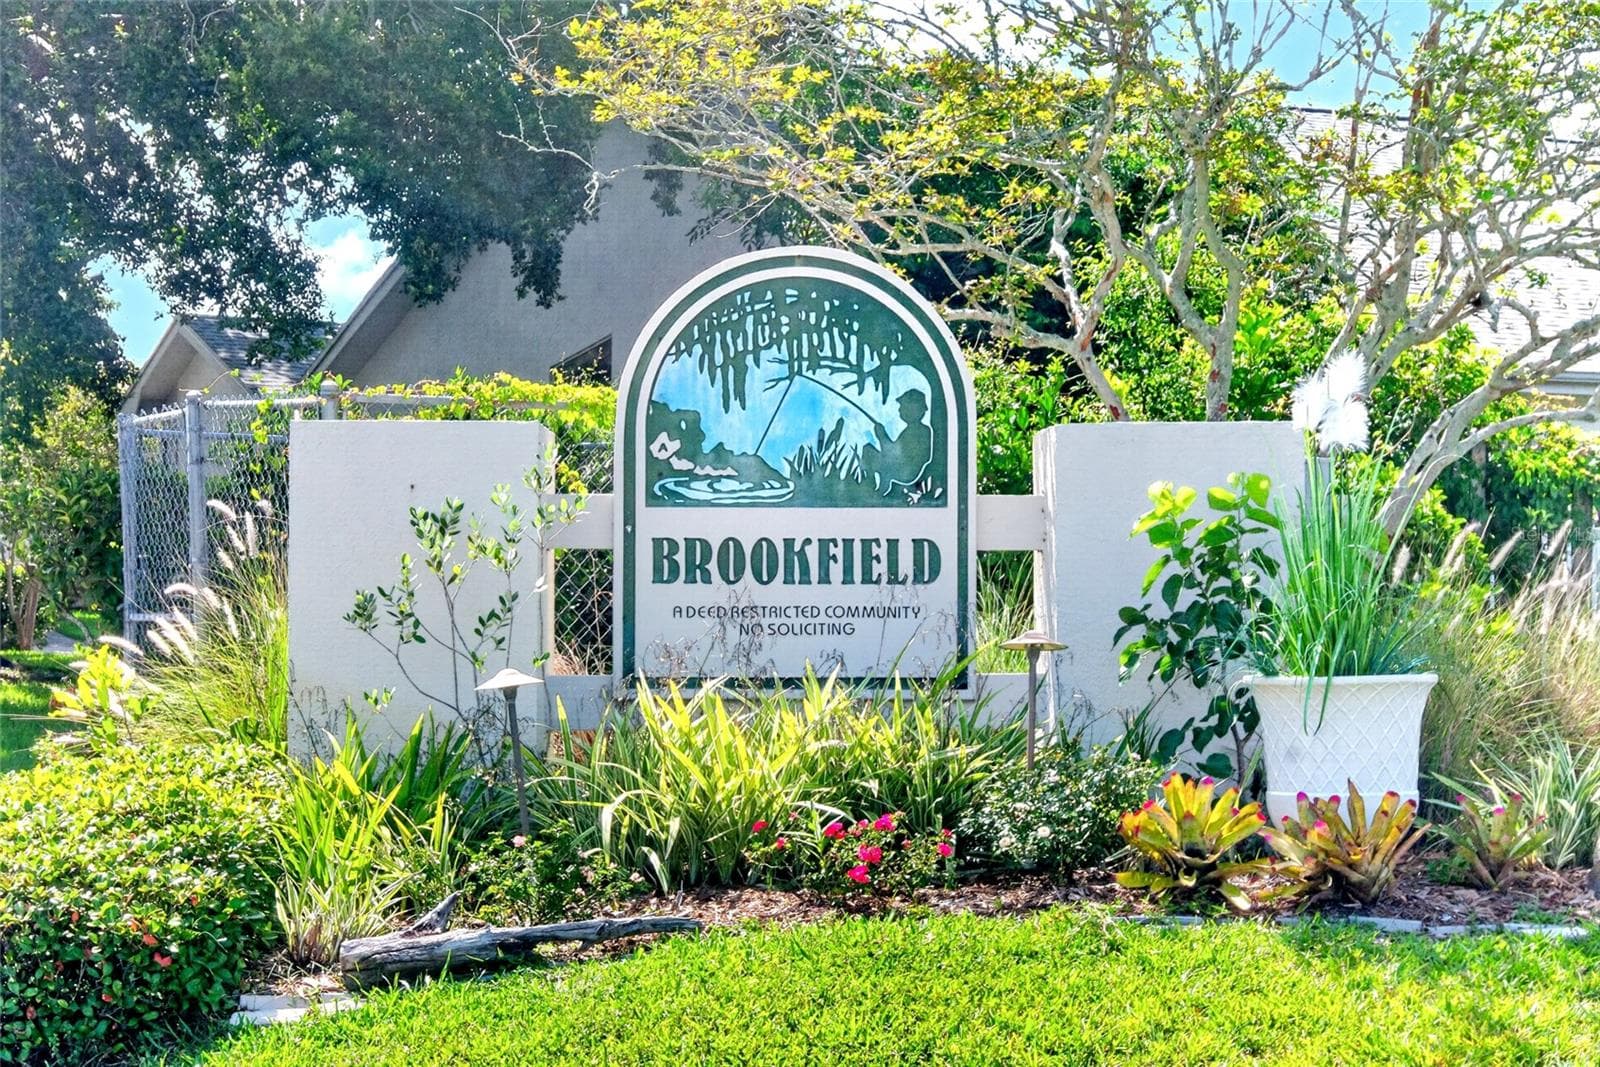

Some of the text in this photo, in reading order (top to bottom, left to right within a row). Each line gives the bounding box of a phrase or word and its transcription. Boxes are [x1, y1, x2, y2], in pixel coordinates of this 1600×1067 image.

[651, 537, 942, 585] BROOKFIELD
[673, 605, 921, 619] A DEED RESTRICTED COMMUNITY
[739, 622, 856, 636] NO SOLICITING
